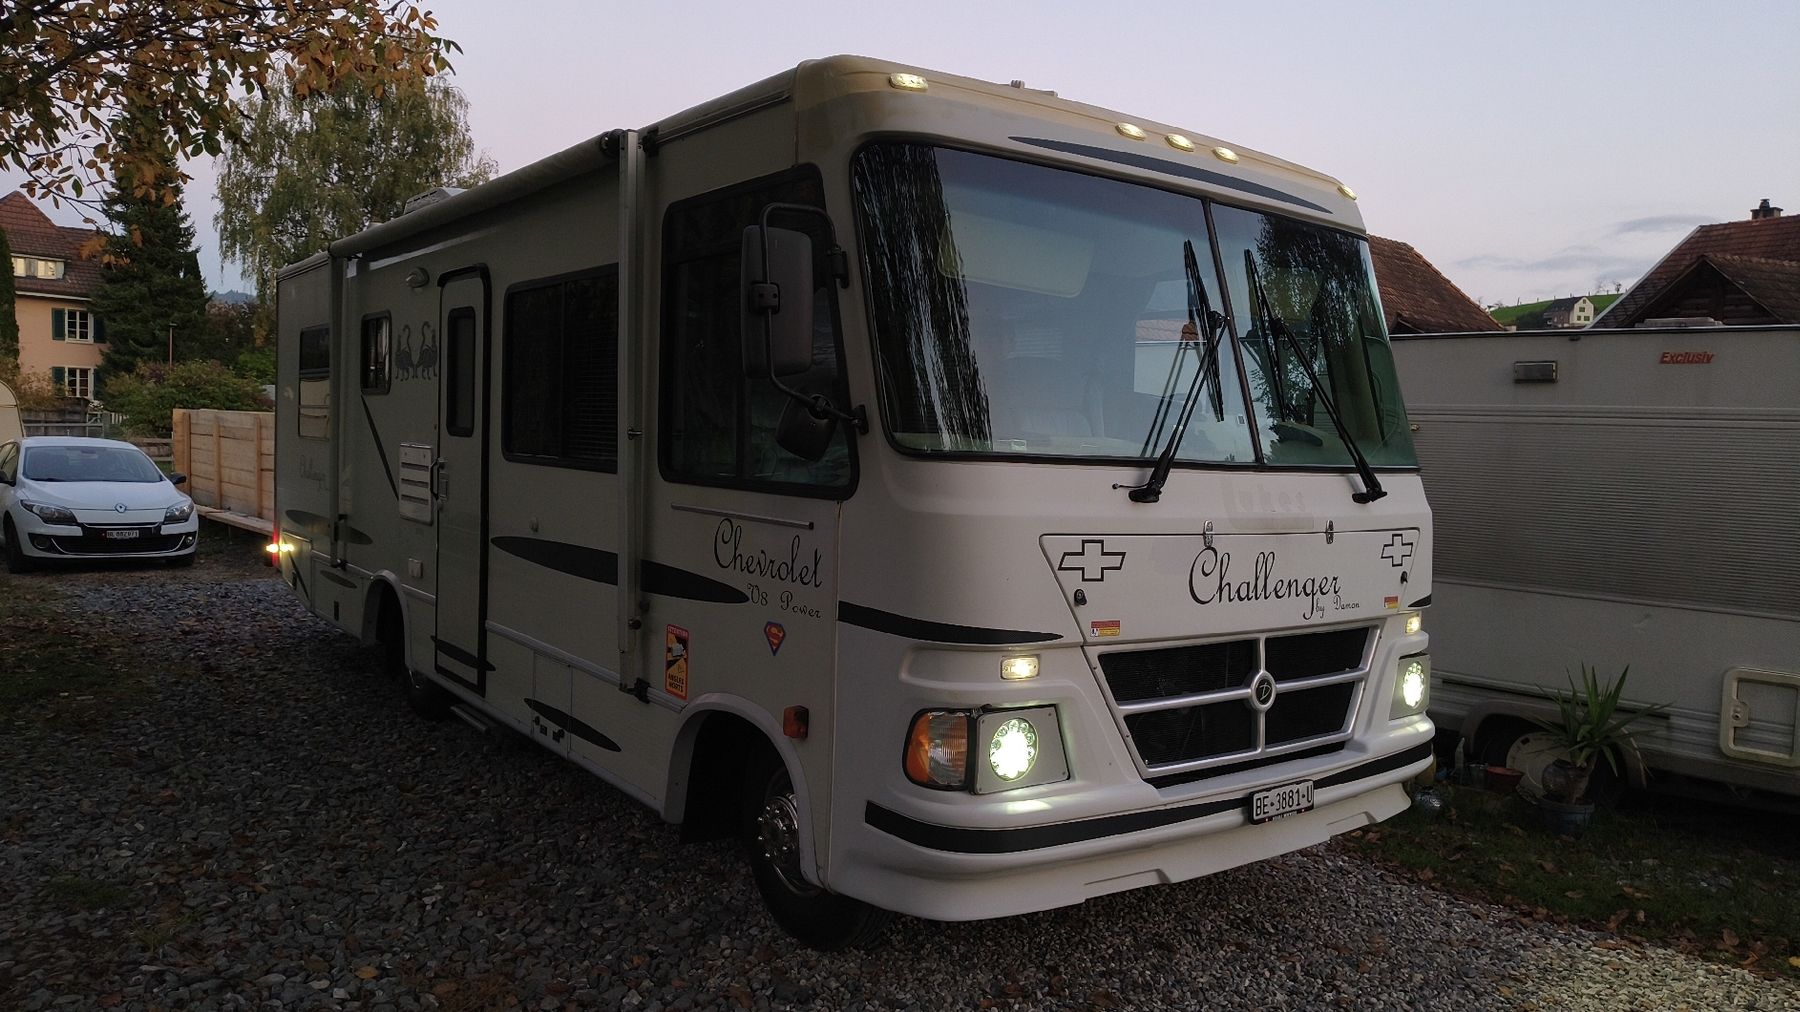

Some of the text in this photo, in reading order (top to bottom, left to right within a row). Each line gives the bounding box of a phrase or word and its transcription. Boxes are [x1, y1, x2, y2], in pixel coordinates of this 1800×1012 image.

[1659, 351, 1714, 364] Exclusiv
[714, 518, 822, 588] Chevrolet
[747, 583, 821, 619] V8 Power
[1189, 546, 1341, 620] Challenger
